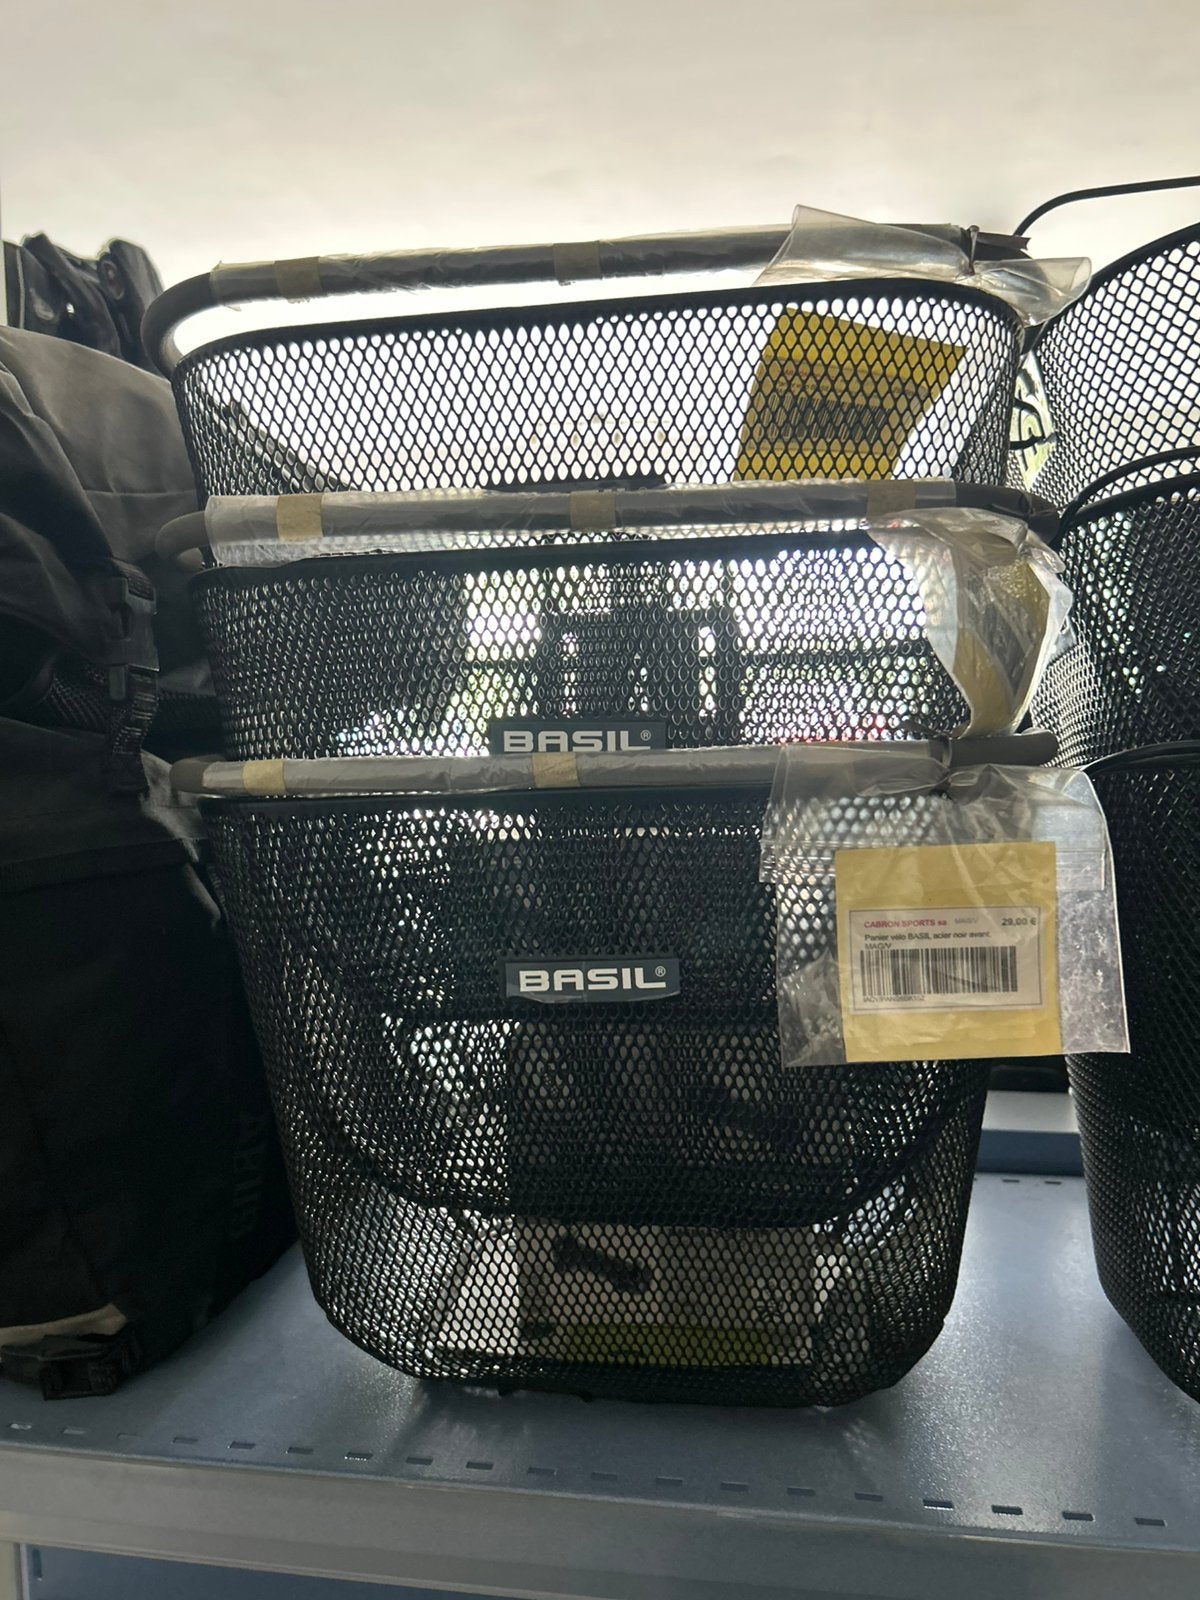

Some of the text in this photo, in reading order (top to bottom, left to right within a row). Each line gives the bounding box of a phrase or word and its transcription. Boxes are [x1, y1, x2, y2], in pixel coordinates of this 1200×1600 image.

[863, 919, 900, 929] CABRON
[901, 918, 936, 928] SPORTS
[1001, 917, 1028, 926] 29,00
[864, 933, 888, 942] Panier
[933, 931, 951, 939] acier
